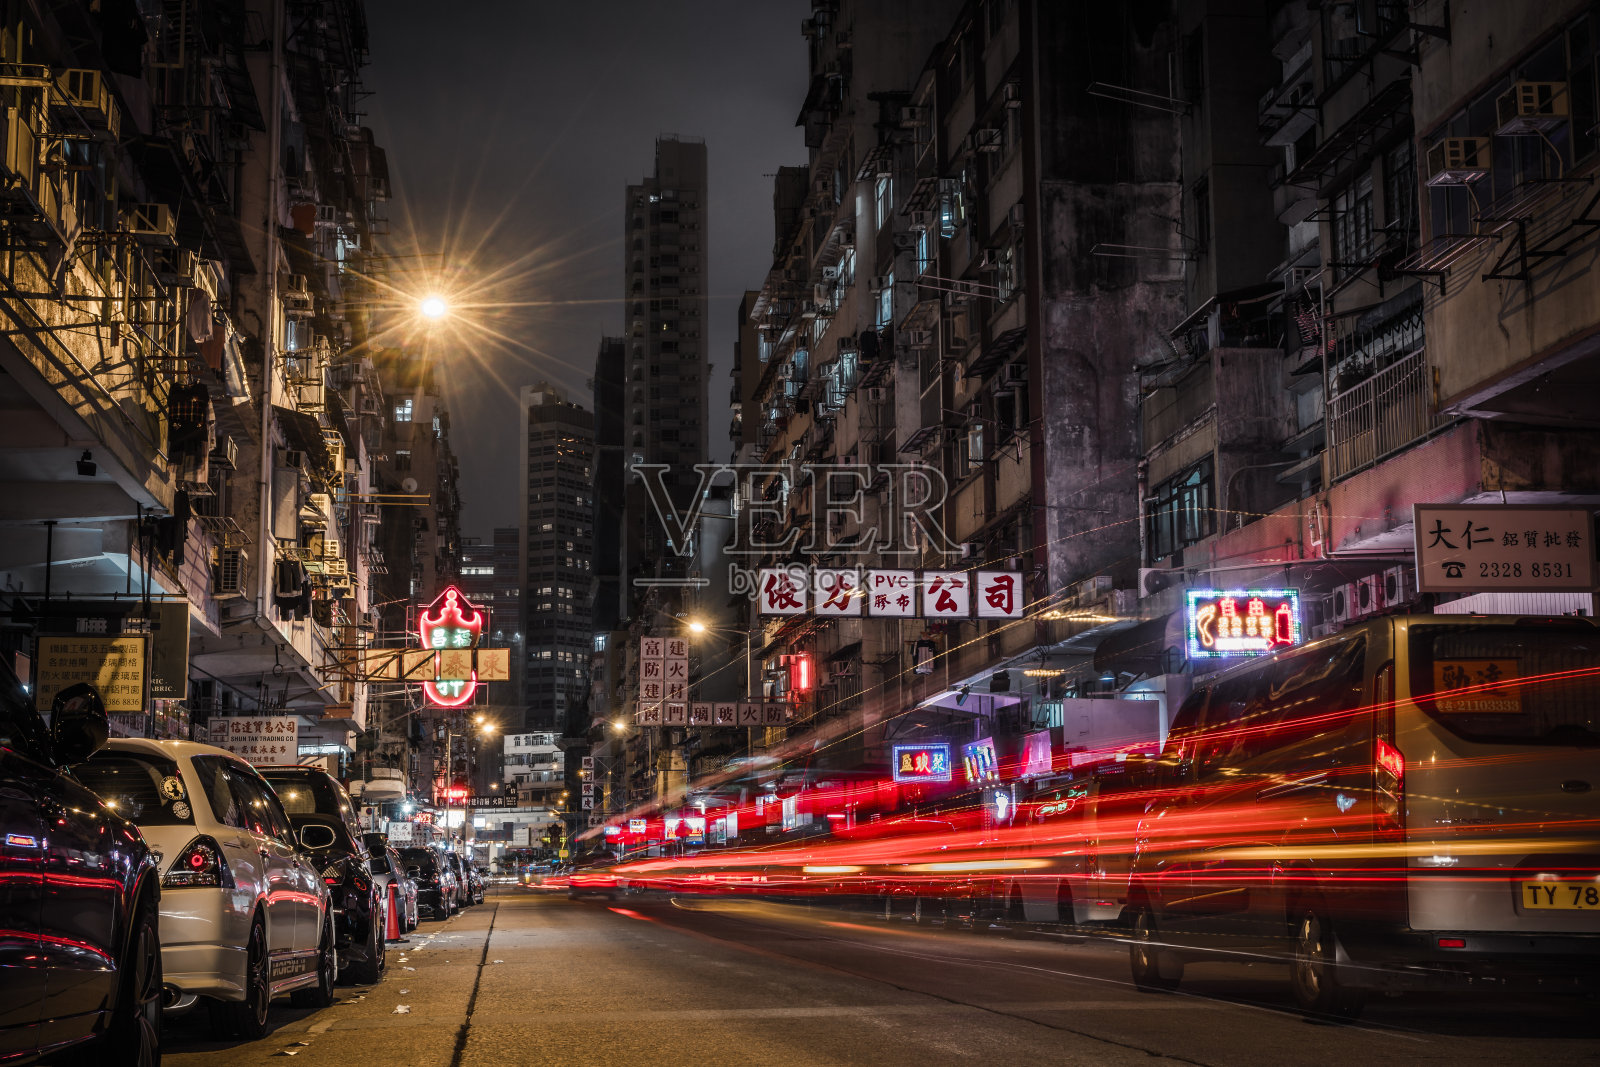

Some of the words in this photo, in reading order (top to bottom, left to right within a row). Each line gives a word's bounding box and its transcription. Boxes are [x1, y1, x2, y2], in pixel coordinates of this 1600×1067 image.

[1427, 519, 1495, 550] 大仁
[1480, 562, 1522, 578] 2328
[1531, 562, 1573, 578] 8531
[875, 575, 910, 588] PVC
[928, 574, 1015, 615] 公司
[122, 698, 140, 706] 8836
[230, 721, 296, 734] 信達貿易公司
[1528, 885, 1558, 905] TY
[1568, 886, 1600, 906] 78
